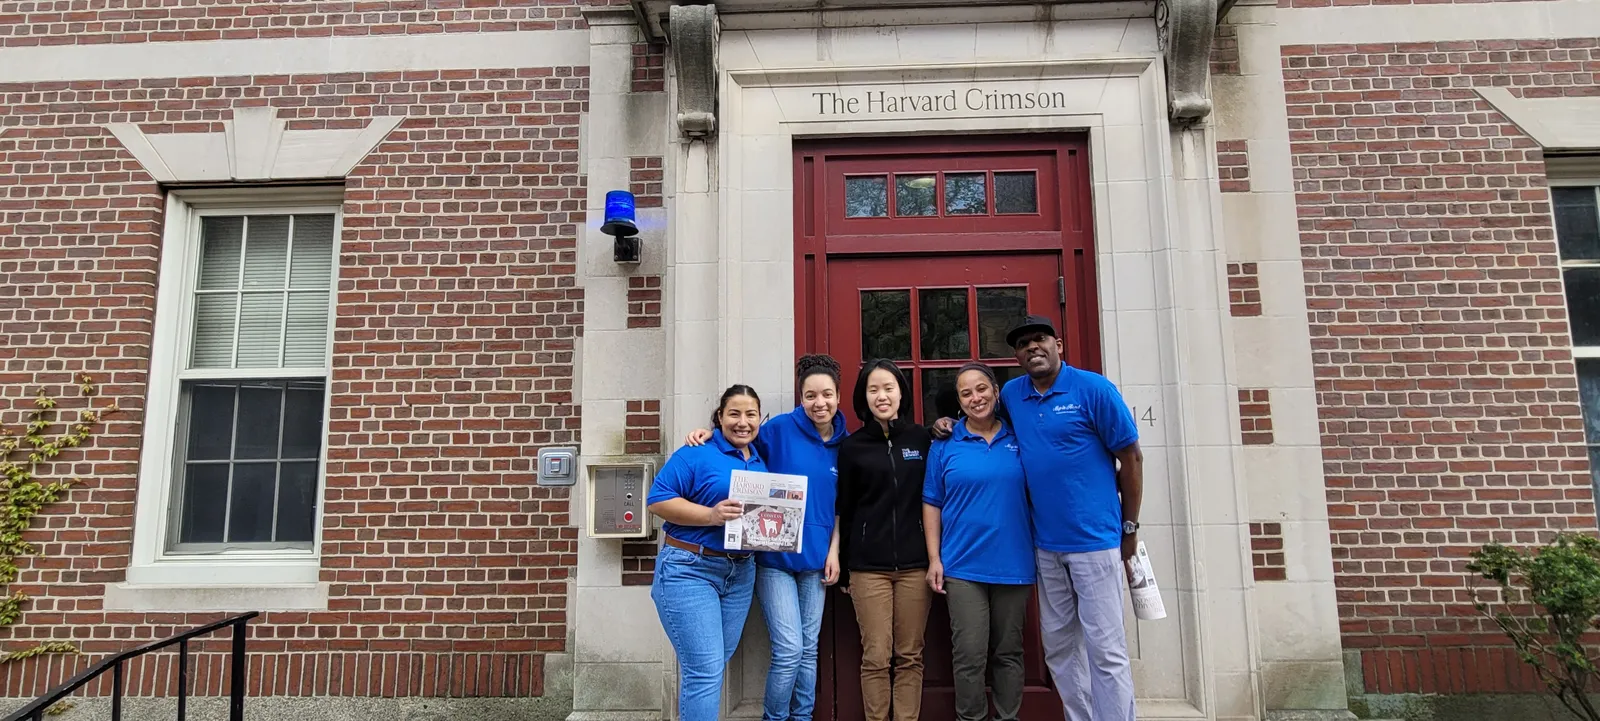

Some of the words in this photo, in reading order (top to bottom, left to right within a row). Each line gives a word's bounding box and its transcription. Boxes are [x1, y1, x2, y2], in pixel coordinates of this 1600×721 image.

[812, 92, 860, 115] The
[866, 90, 957, 114] Harvard
[965, 88, 1066, 112] Crimson
[1132, 405, 1157, 427] 14
[732, 487, 764, 496] CRIMSON
[733, 481, 765, 490] HARVARD
